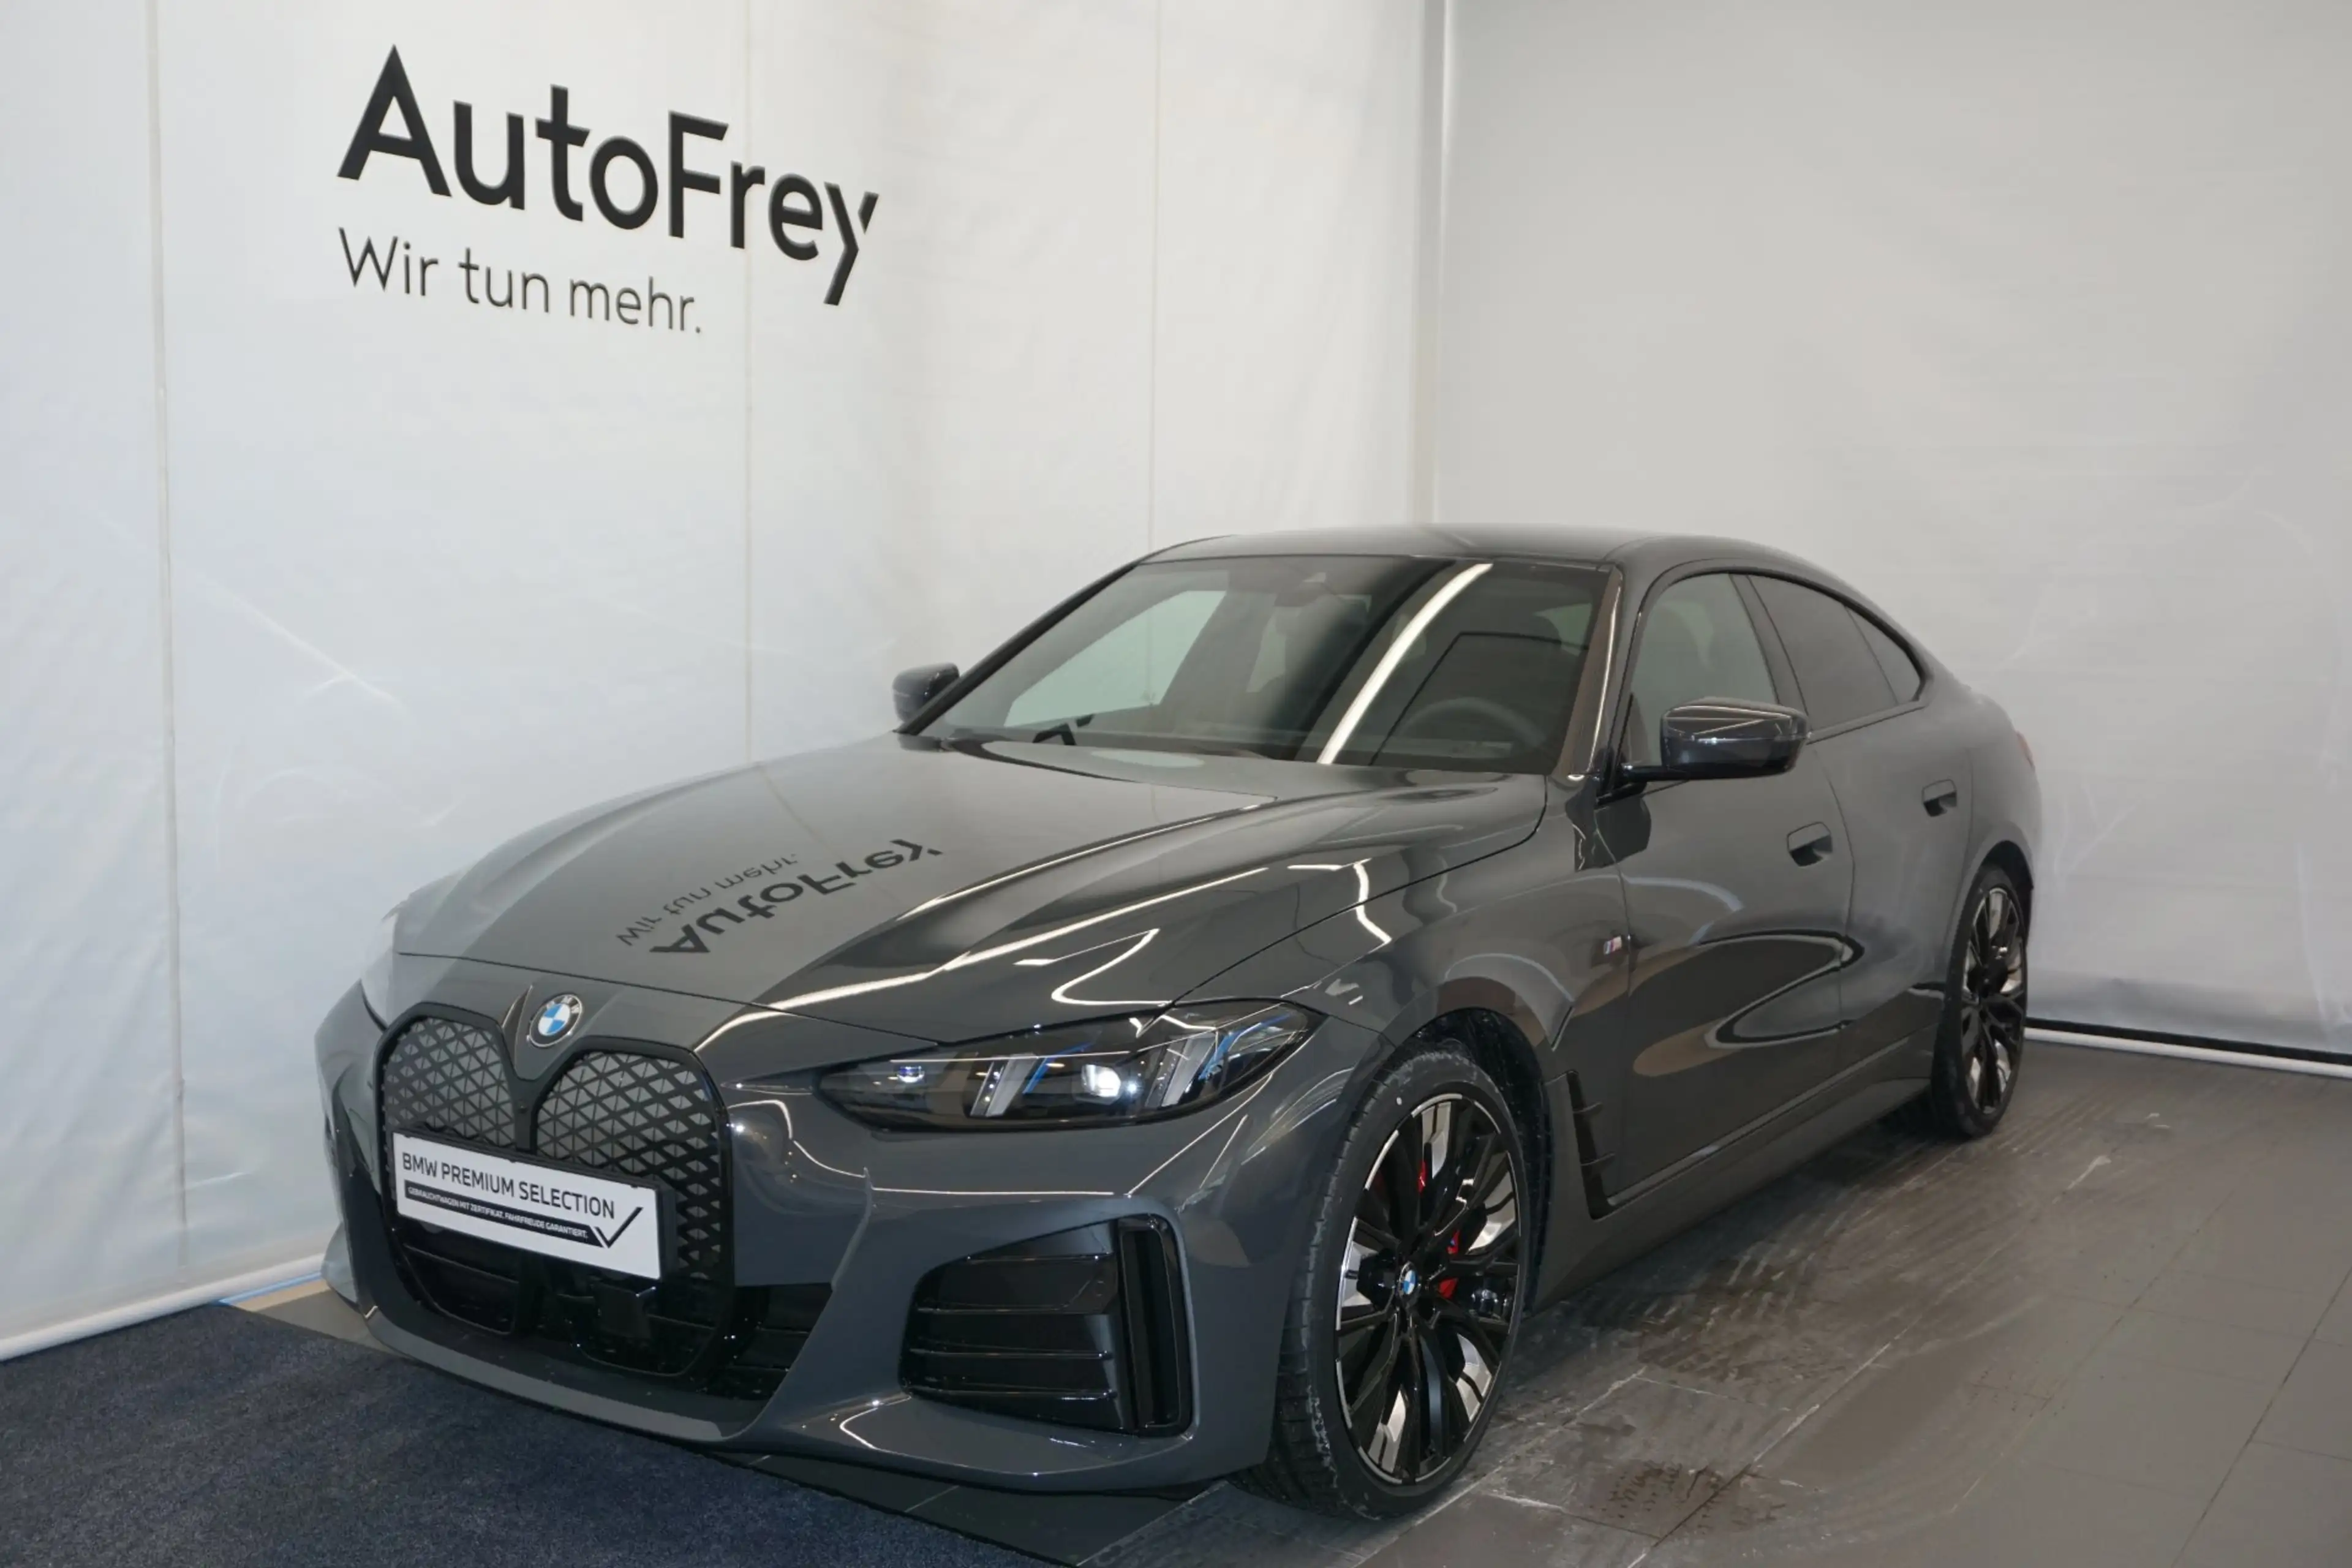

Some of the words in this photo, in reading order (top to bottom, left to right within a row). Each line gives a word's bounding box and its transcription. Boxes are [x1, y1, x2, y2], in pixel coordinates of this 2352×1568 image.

[337, 44, 879, 306] AutoFrey
[338, 227, 439, 296] Wir
[458, 247, 550, 314] tun
[570, 276, 702, 334] mehr.
[402, 1152, 438, 1178] BMW
[442, 1161, 515, 1198] PREMIUM
[519, 1180, 615, 1219] SELECTION
[407, 1186, 459, 1208] GEBRAUCHTWAGEN
[459, 1200, 470, 1210] MIT
